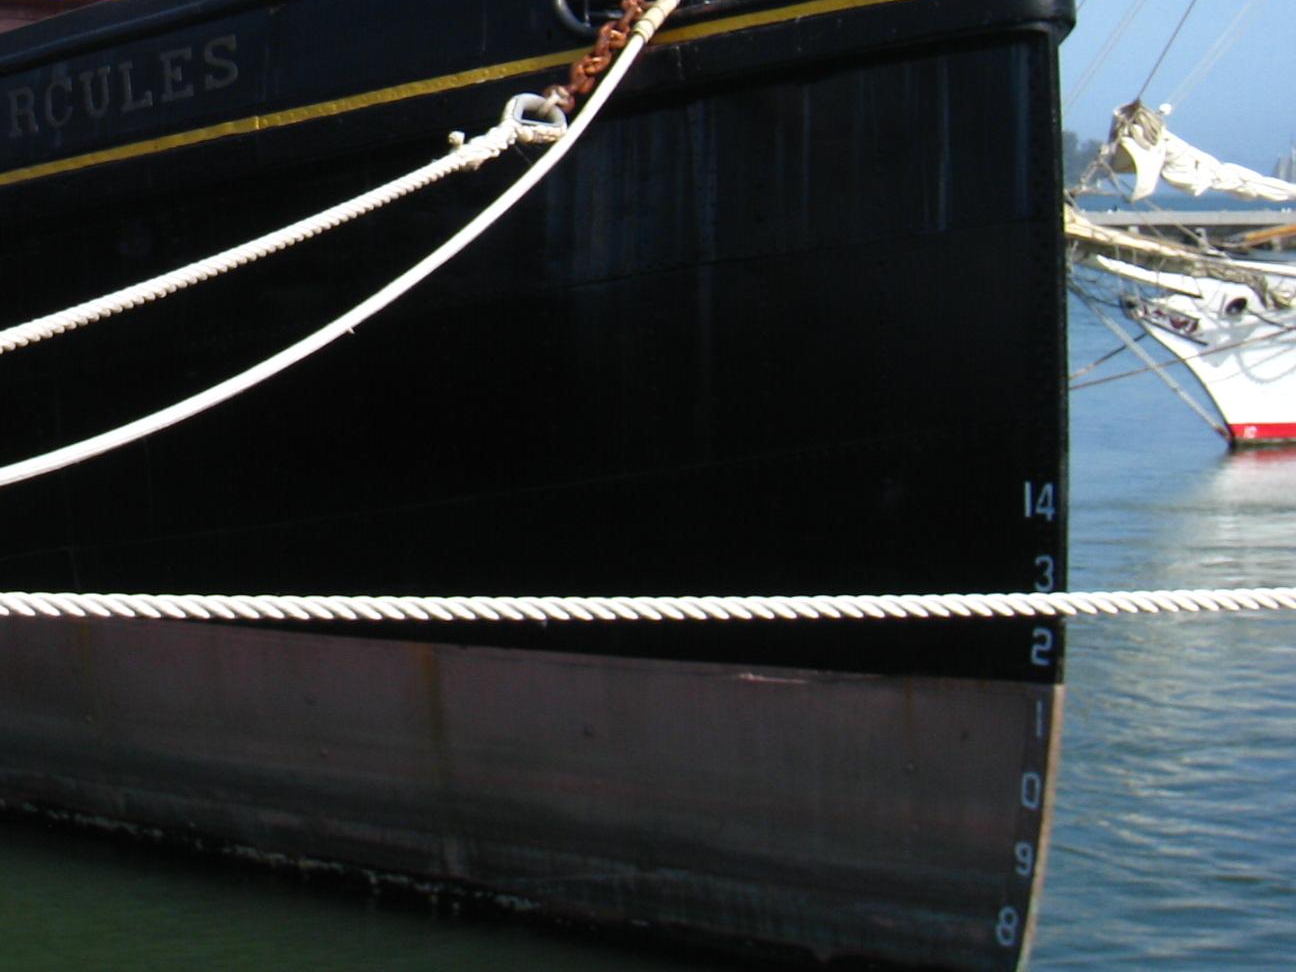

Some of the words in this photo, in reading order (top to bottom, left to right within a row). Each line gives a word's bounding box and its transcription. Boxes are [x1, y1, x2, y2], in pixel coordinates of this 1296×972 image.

[1024, 481, 1055, 522] 14
[1034, 554, 1054, 593] 3
[1030, 628, 1053, 666] 2
[1035, 700, 1043, 737] 1
[1021, 772, 1041, 810] 0
[1014, 841, 1034, 875] 9
[996, 906, 1019, 947] 8
